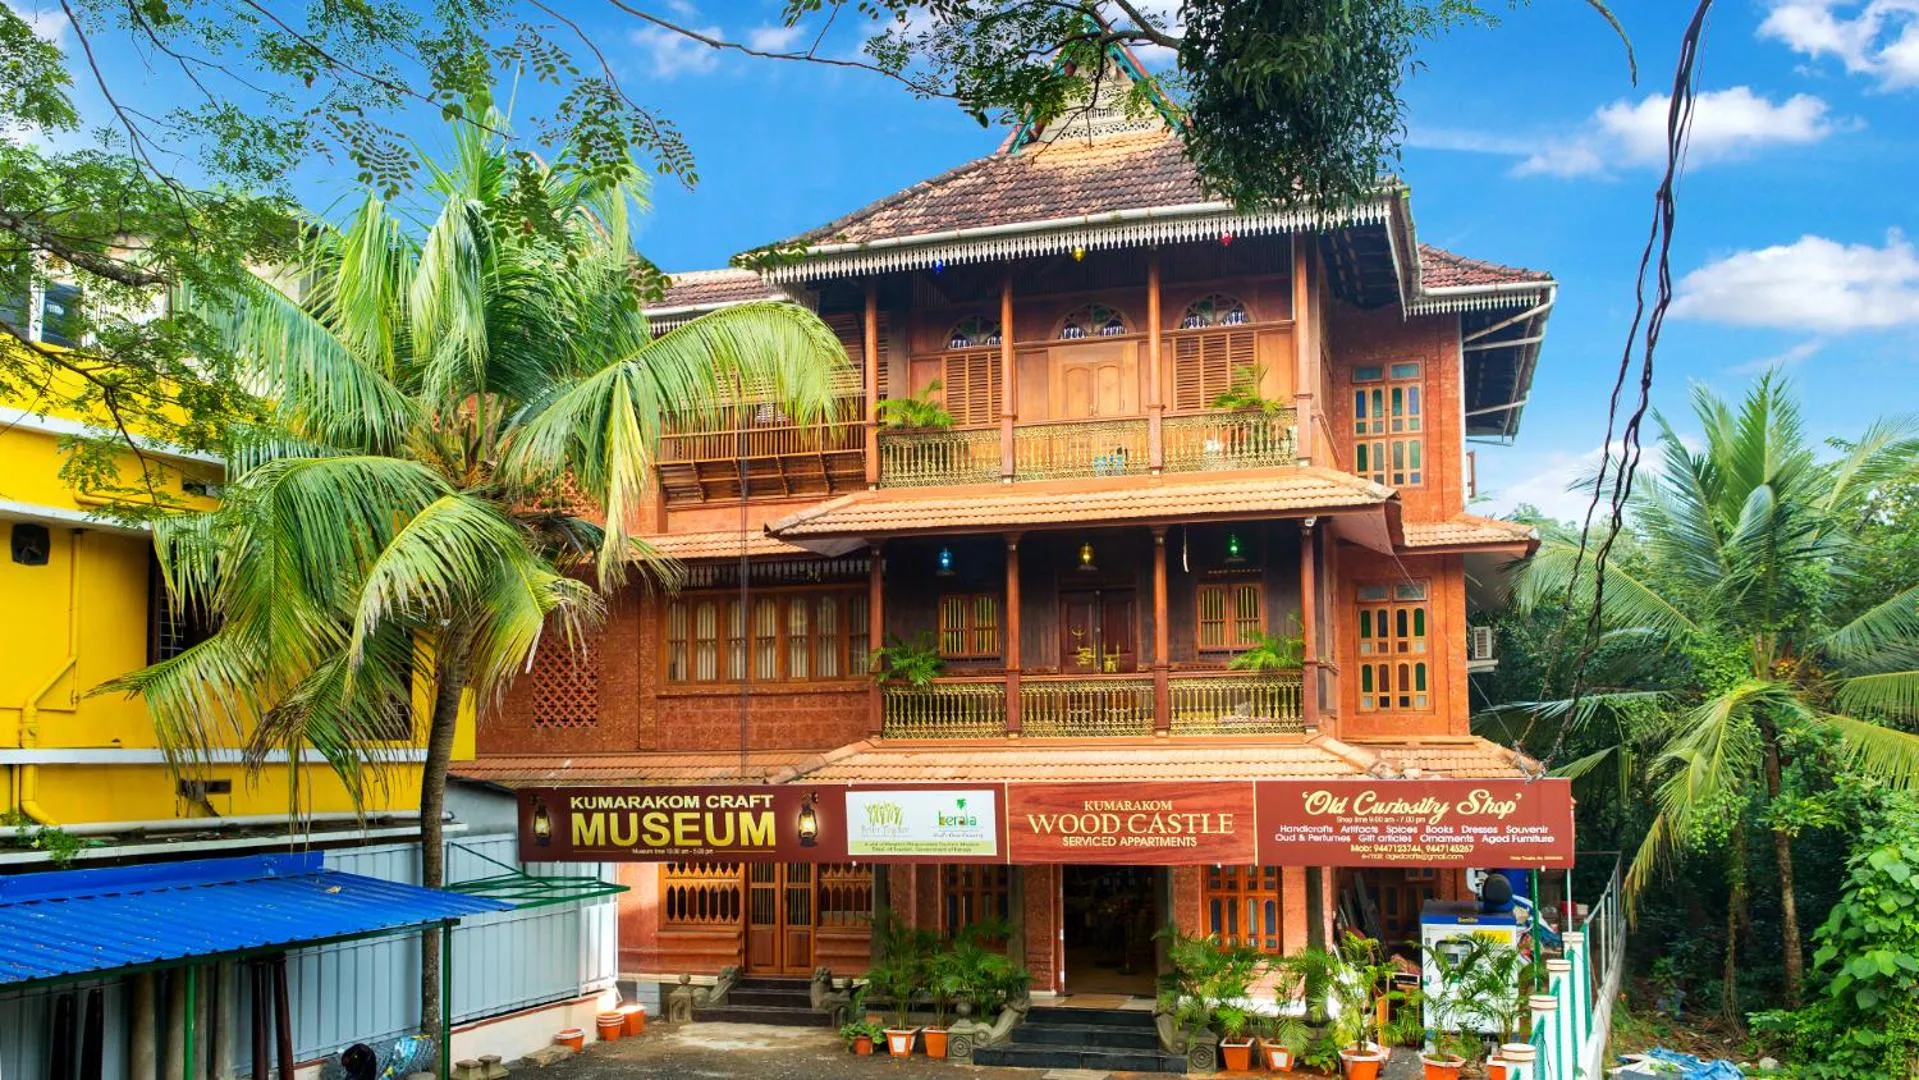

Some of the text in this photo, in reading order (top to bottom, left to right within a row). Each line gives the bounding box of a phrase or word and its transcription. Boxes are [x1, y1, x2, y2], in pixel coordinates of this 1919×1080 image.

[570, 794, 774, 810] KUMARAKOM CRAFT
[1084, 800, 1172, 811] KUMARAKOM
[1353, 790, 1450, 825] Curiosity
[938, 810, 977, 826] kerala
[1027, 813, 1234, 834] WOOD CASTLE
[571, 811, 776, 847] MUSEUM
[1280, 825, 1548, 835] Handicrafts Artifacts Spices Books Dresses Souvenir
[1062, 836, 1197, 847] SERVICED APPARTMENTS
[1275, 833, 1554, 844] Oud & Perfumes Gift articles Ornaments Aged Furniture
